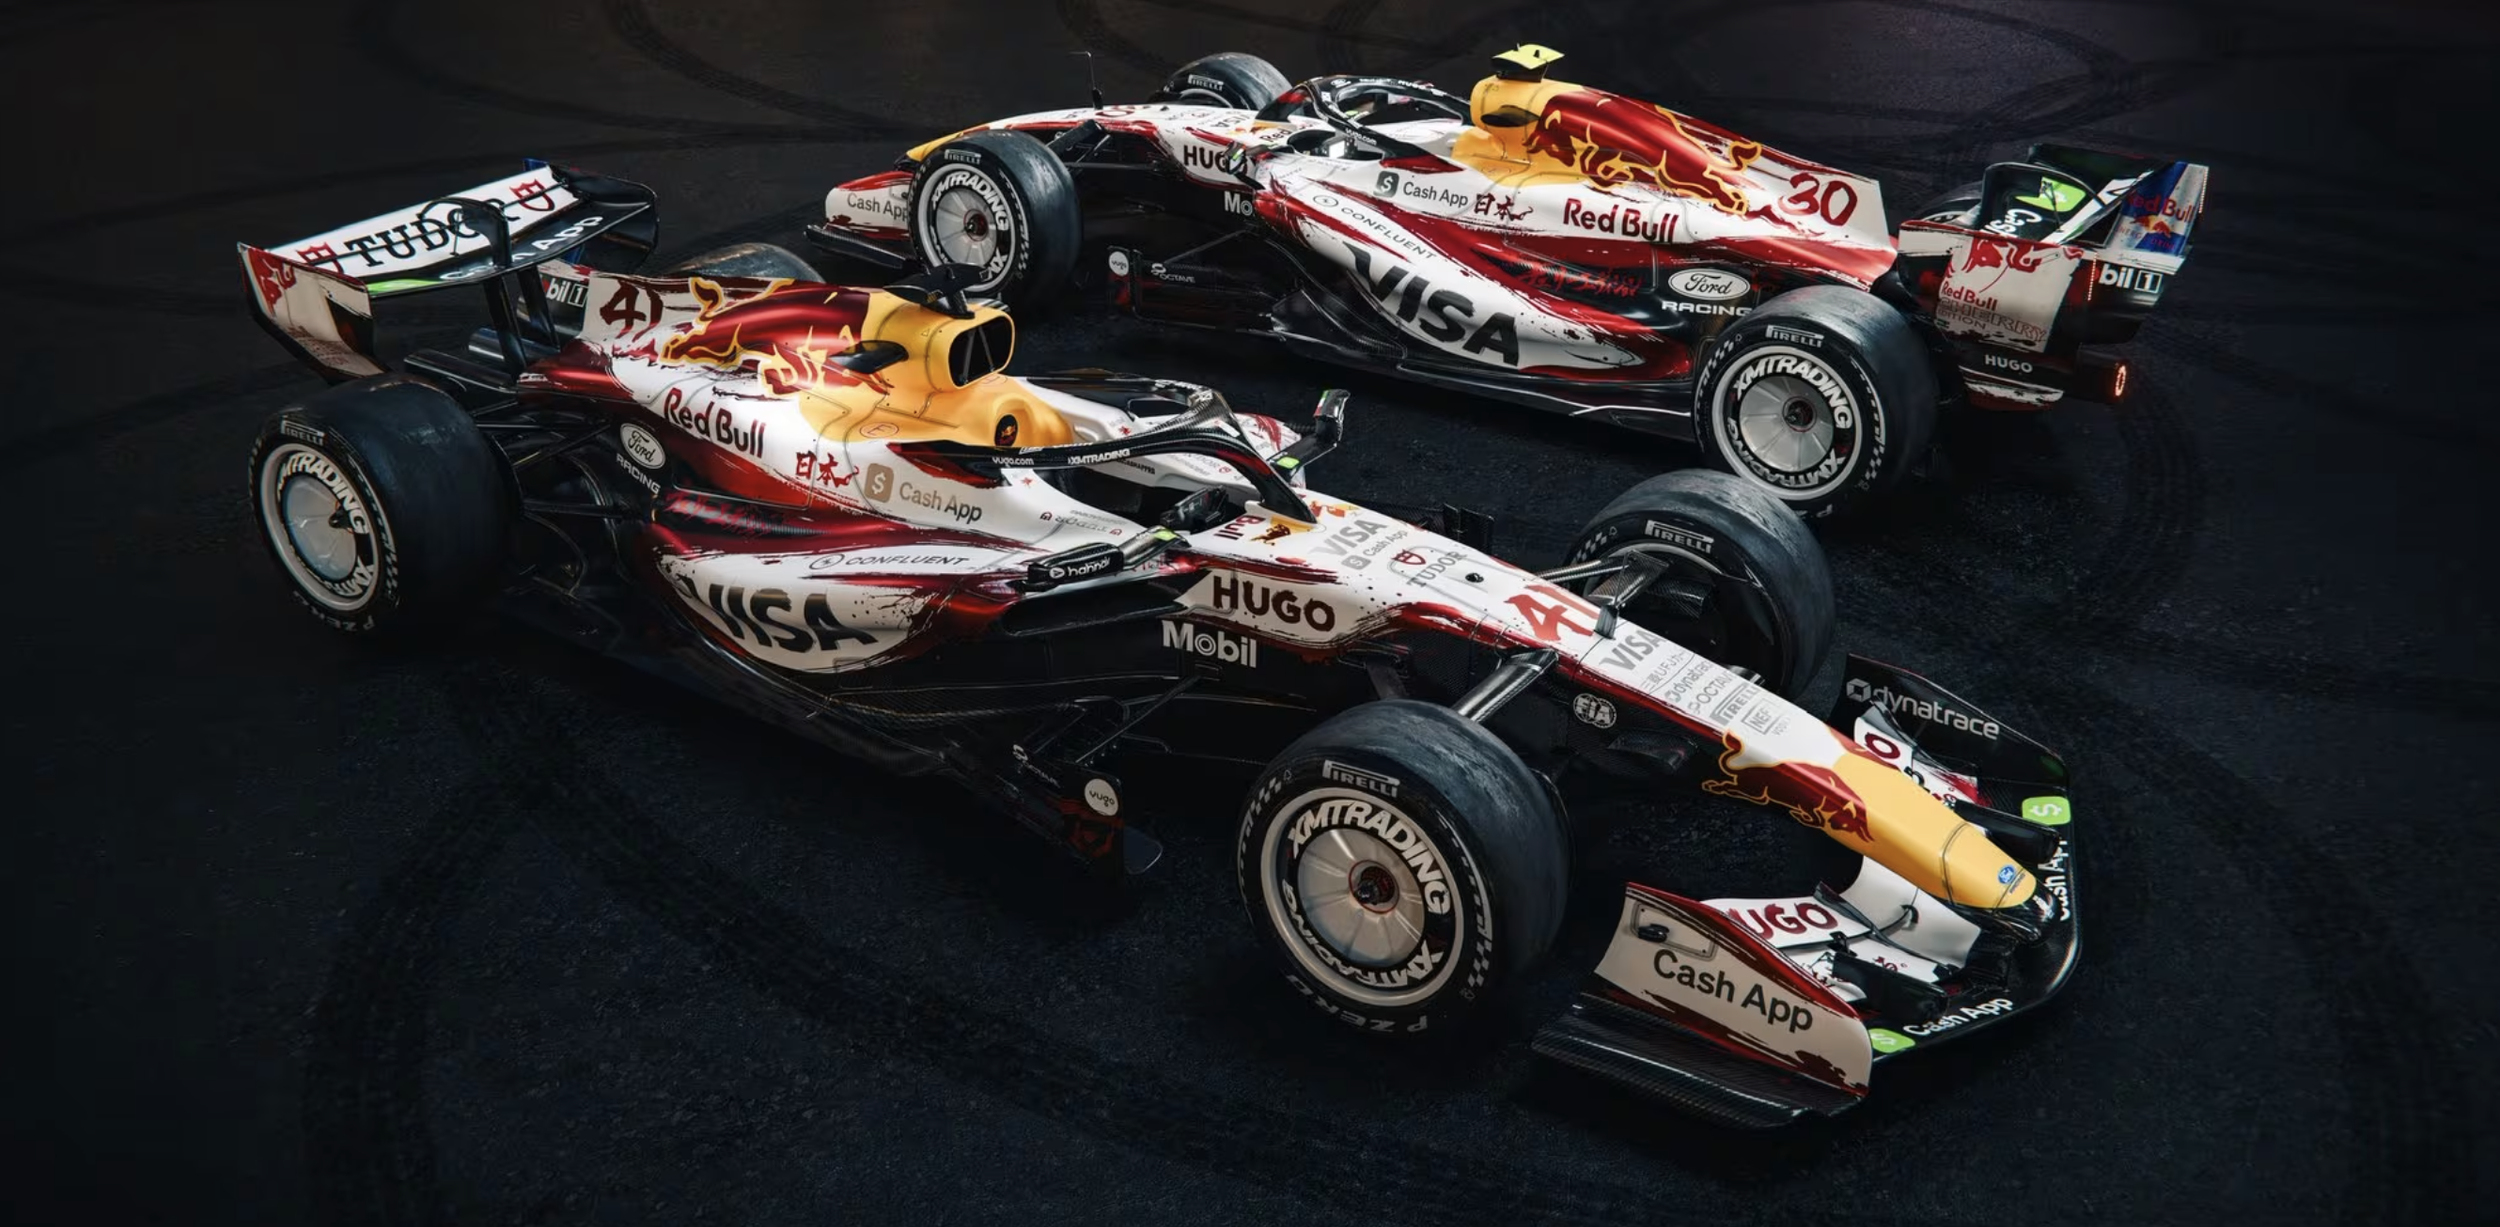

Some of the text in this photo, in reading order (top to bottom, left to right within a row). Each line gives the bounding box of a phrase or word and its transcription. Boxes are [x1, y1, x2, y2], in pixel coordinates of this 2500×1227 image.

[847, 192, 881, 213] Cash
[1403, 181, 1469, 209] Cash App
[1474, 192, 1519, 221] 日本
[1777, 172, 1858, 227] 30
[531, 216, 604, 251] App
[1341, 206, 1437, 259] CONFLUENT
[1562, 197, 1680, 244] Red Bull
[1160, 273, 1196, 283] OCTAVE
[1684, 271, 1733, 297] Ford
[1942, 280, 1998, 311] Red Bull
[1345, 241, 1521, 367] VISA
[1661, 300, 1753, 317] RACING
[1765, 324, 1824, 348] PIRELLI
[1984, 354, 2033, 374] HUGO
[1732, 355, 1852, 430] XMTRADING
[663, 386, 767, 459] Red Bull
[627, 430, 655, 464] Ford
[992, 455, 1035, 470] vugo.com
[1068, 447, 1131, 465] XMTRADING
[616, 452, 662, 496] RACING
[899, 481, 983, 523] Cash App
[1213, 514, 1266, 541] Bull
[1309, 518, 1388, 557] VISA
[1362, 529, 1409, 558] Cash App
[1644, 519, 1715, 554] PIRELLI
[843, 555, 970, 567] CONFLUENT
[1406, 550, 1468, 589] TUDOR
[674, 572, 879, 654] VISA
[1211, 575, 1336, 632] HUGO
[1161, 620, 1257, 669] Mobil
[1599, 628, 1668, 672] VISA
[1873, 686, 2000, 740] dynatrace
[1089, 789, 1116, 807] vugo
[1322, 759, 1401, 798] PIRELLI
[1287, 799, 1451, 915] XMTRADING
[1653, 948, 1814, 1034] Cash App
[1902, 997, 2014, 1037] Cash App
